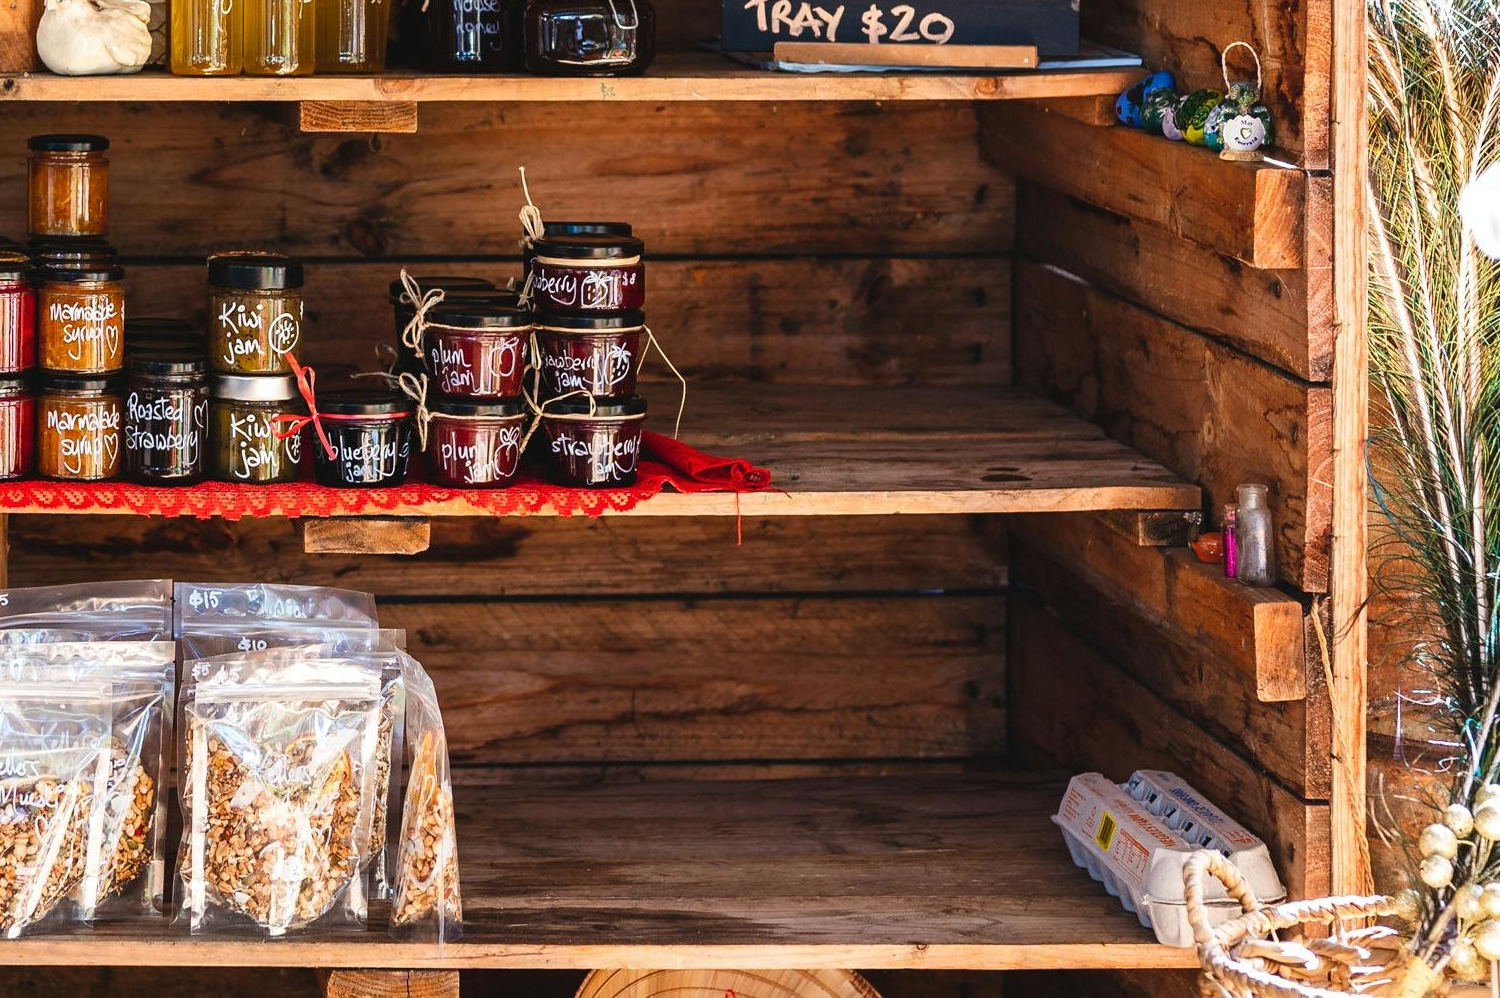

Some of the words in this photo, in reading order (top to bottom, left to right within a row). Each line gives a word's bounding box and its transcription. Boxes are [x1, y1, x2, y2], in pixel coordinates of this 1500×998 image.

[861, 3, 956, 45] $20
[49, 299, 117, 323] Marmalade
[218, 301, 264, 335] Kiwi
[63, 323, 102, 361] syrup
[223, 332, 265, 365] jam
[431, 339, 471, 377] plum
[441, 366, 481, 393] jam
[554, 371, 588, 394] jam
[47, 404, 120, 434] Marmalade
[126, 392, 184, 422] Roasted
[61, 435, 104, 474] syrup
[236, 441, 277, 480] jam
[188, 589, 223, 610] $15
[237, 636, 268, 653] $10
